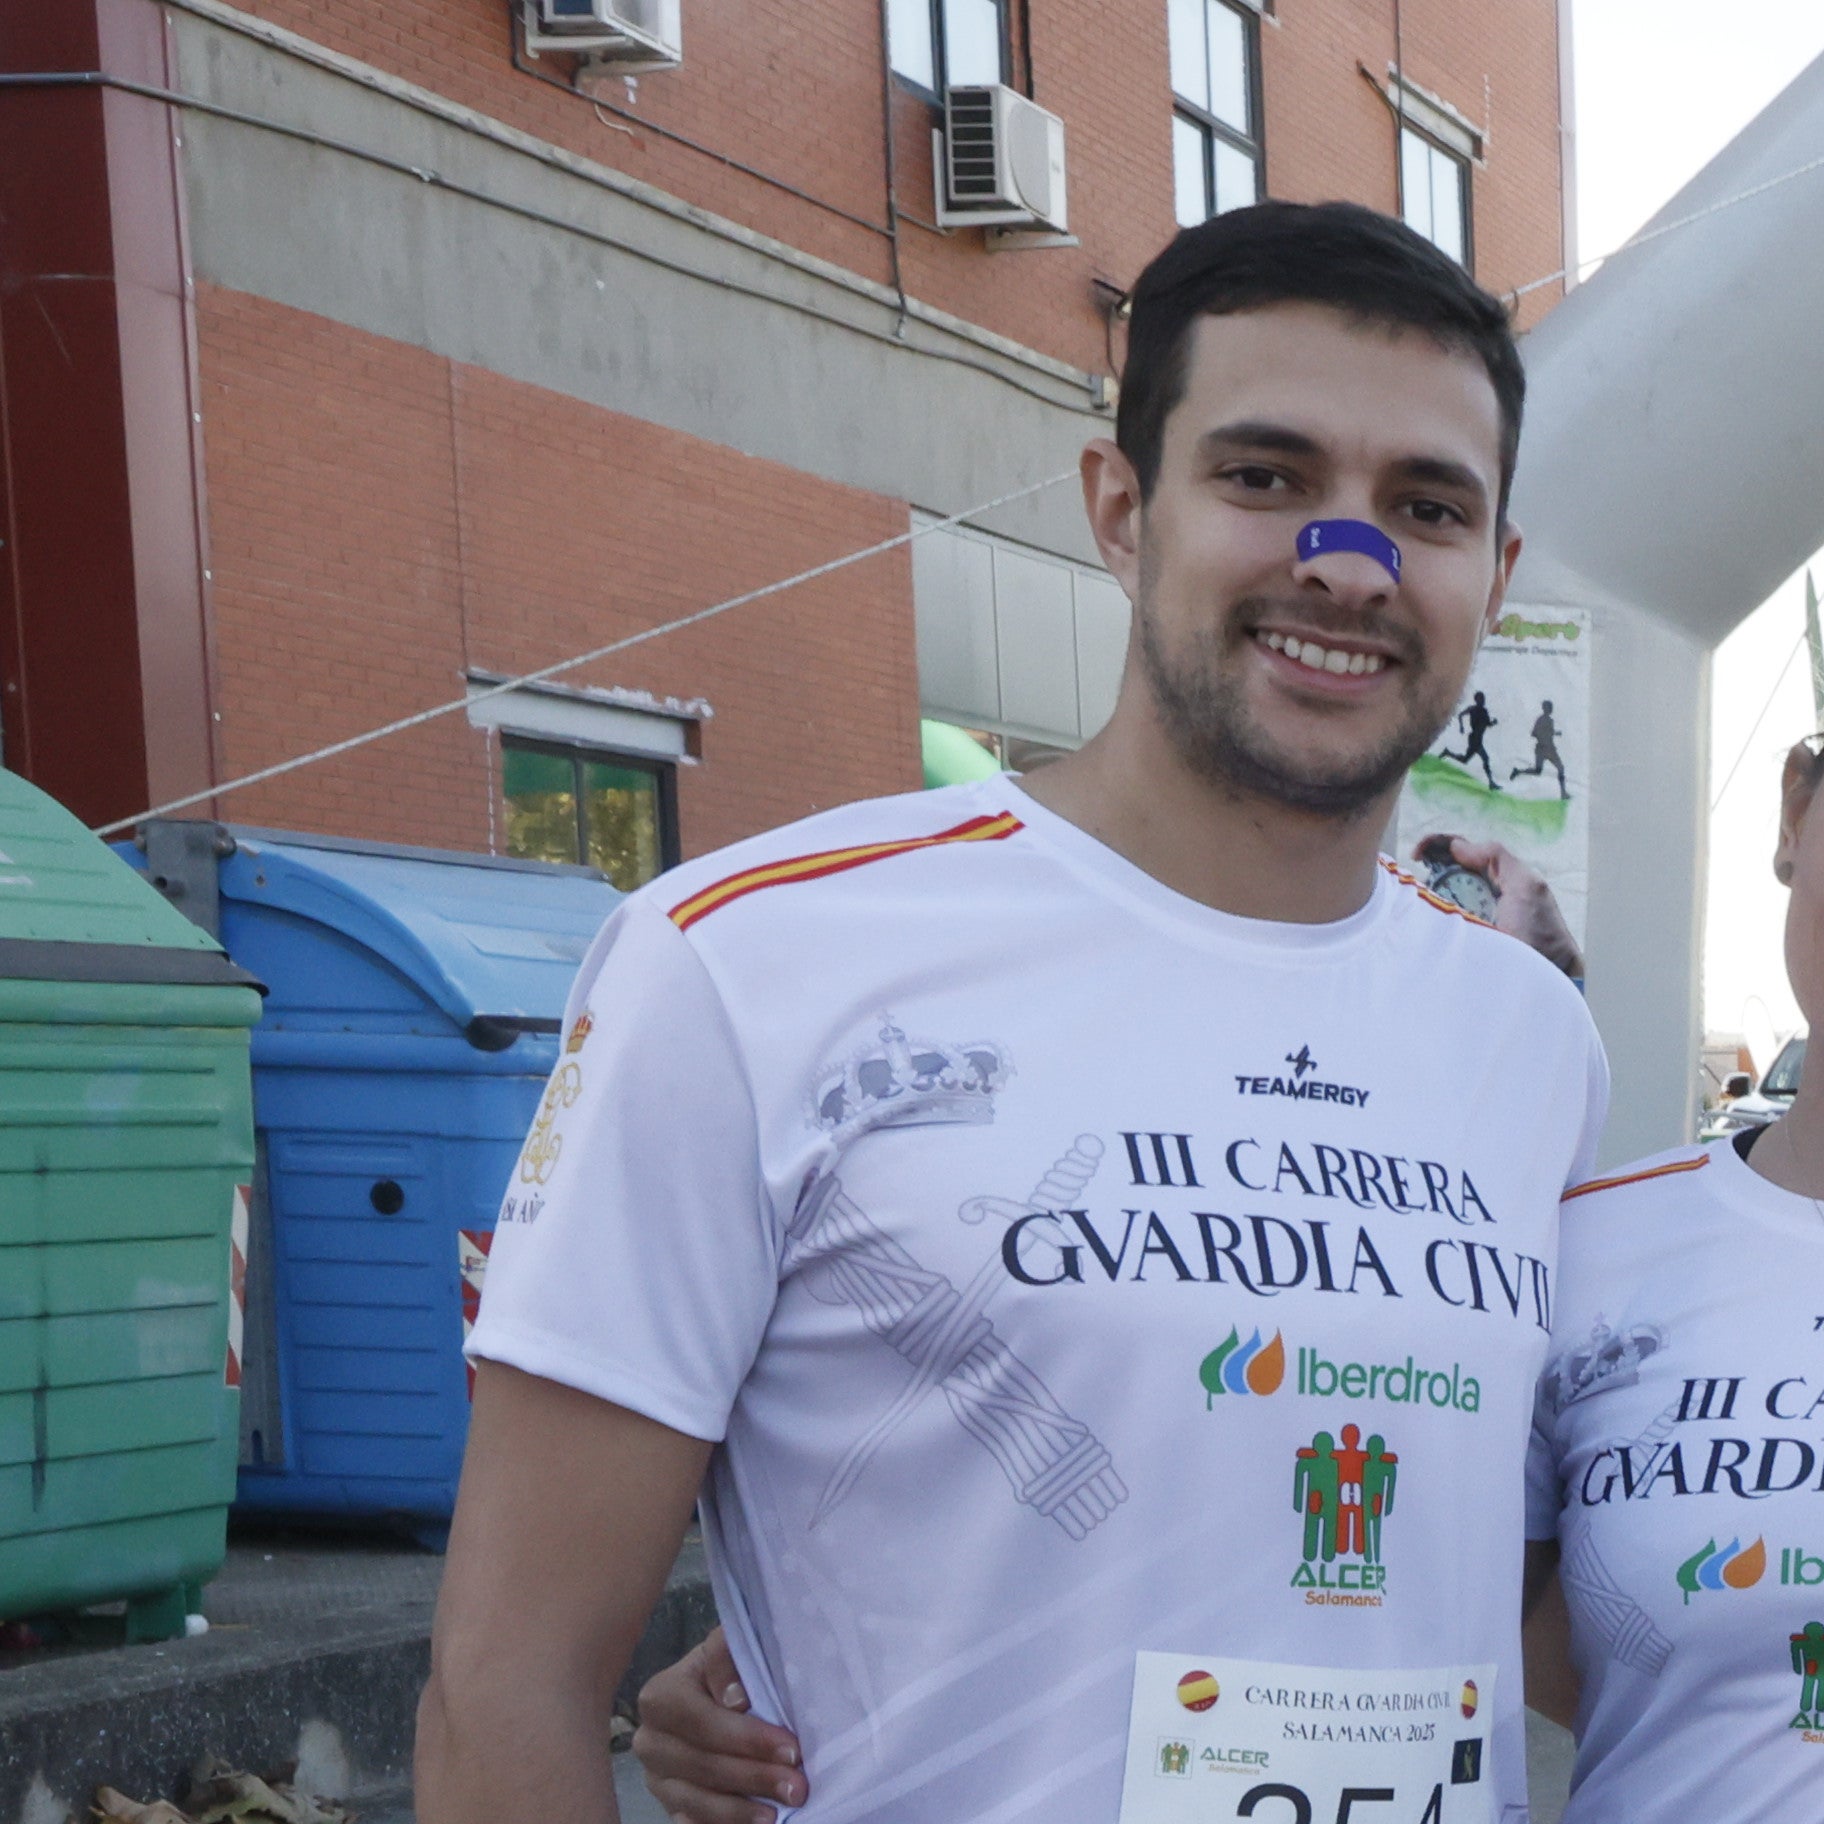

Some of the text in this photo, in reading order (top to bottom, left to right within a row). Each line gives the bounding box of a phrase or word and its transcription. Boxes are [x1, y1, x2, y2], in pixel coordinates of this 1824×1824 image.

[1234, 1075, 1370, 1108] TEAMERGY
[1117, 1130, 1498, 1225] III CARRERA
[1298, 1346, 1482, 1414] Iberdrola
[1672, 1376, 1747, 1424] III
[1289, 1562, 1387, 1596] ALCER
[1244, 1685, 1350, 1711] CARRERA
[1282, 1721, 1436, 1743] SALAMANCA 2025
[1199, 1746, 1270, 1768] ALCER
